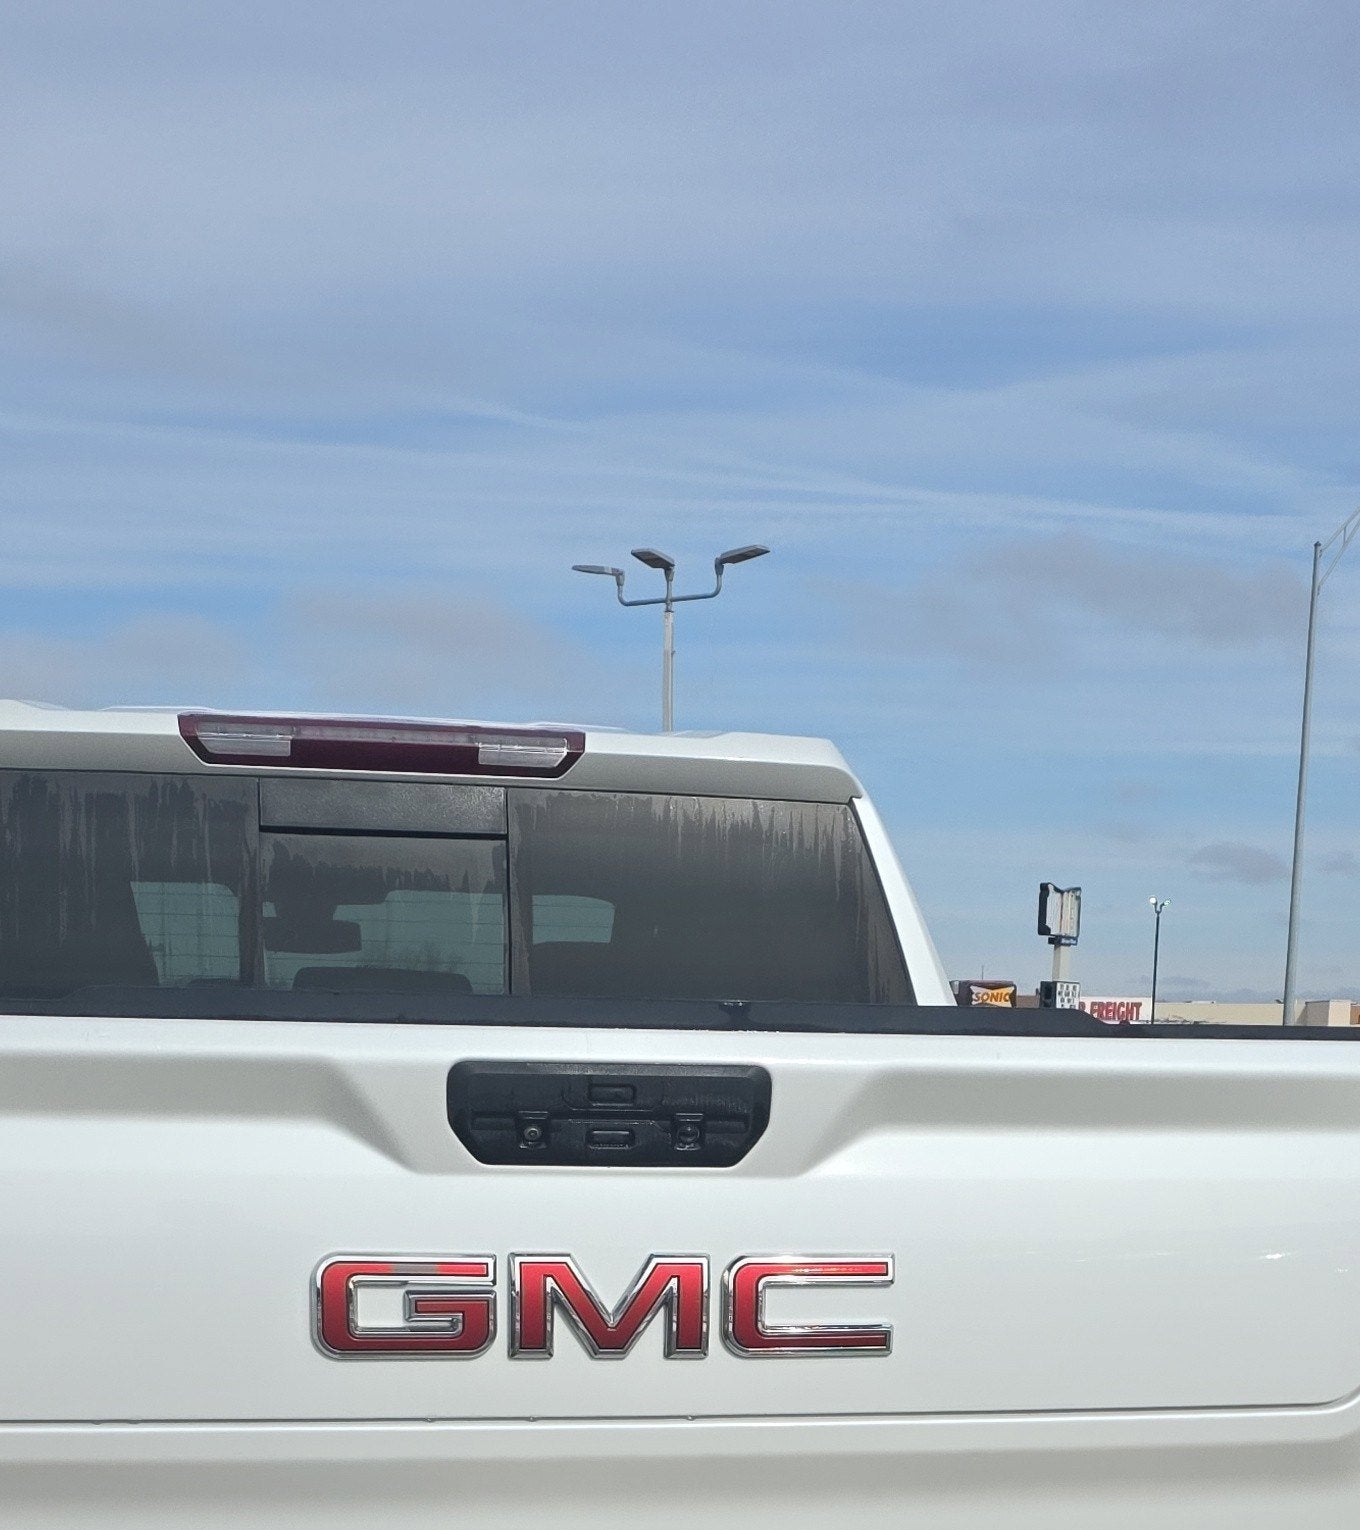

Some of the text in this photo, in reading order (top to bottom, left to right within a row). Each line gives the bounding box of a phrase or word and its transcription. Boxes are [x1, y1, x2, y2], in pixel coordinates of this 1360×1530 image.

[972, 990, 1010, 1003] SONIC
[1090, 1001, 1143, 1021] FREIGHT
[312, 1252, 895, 1360] GMC
